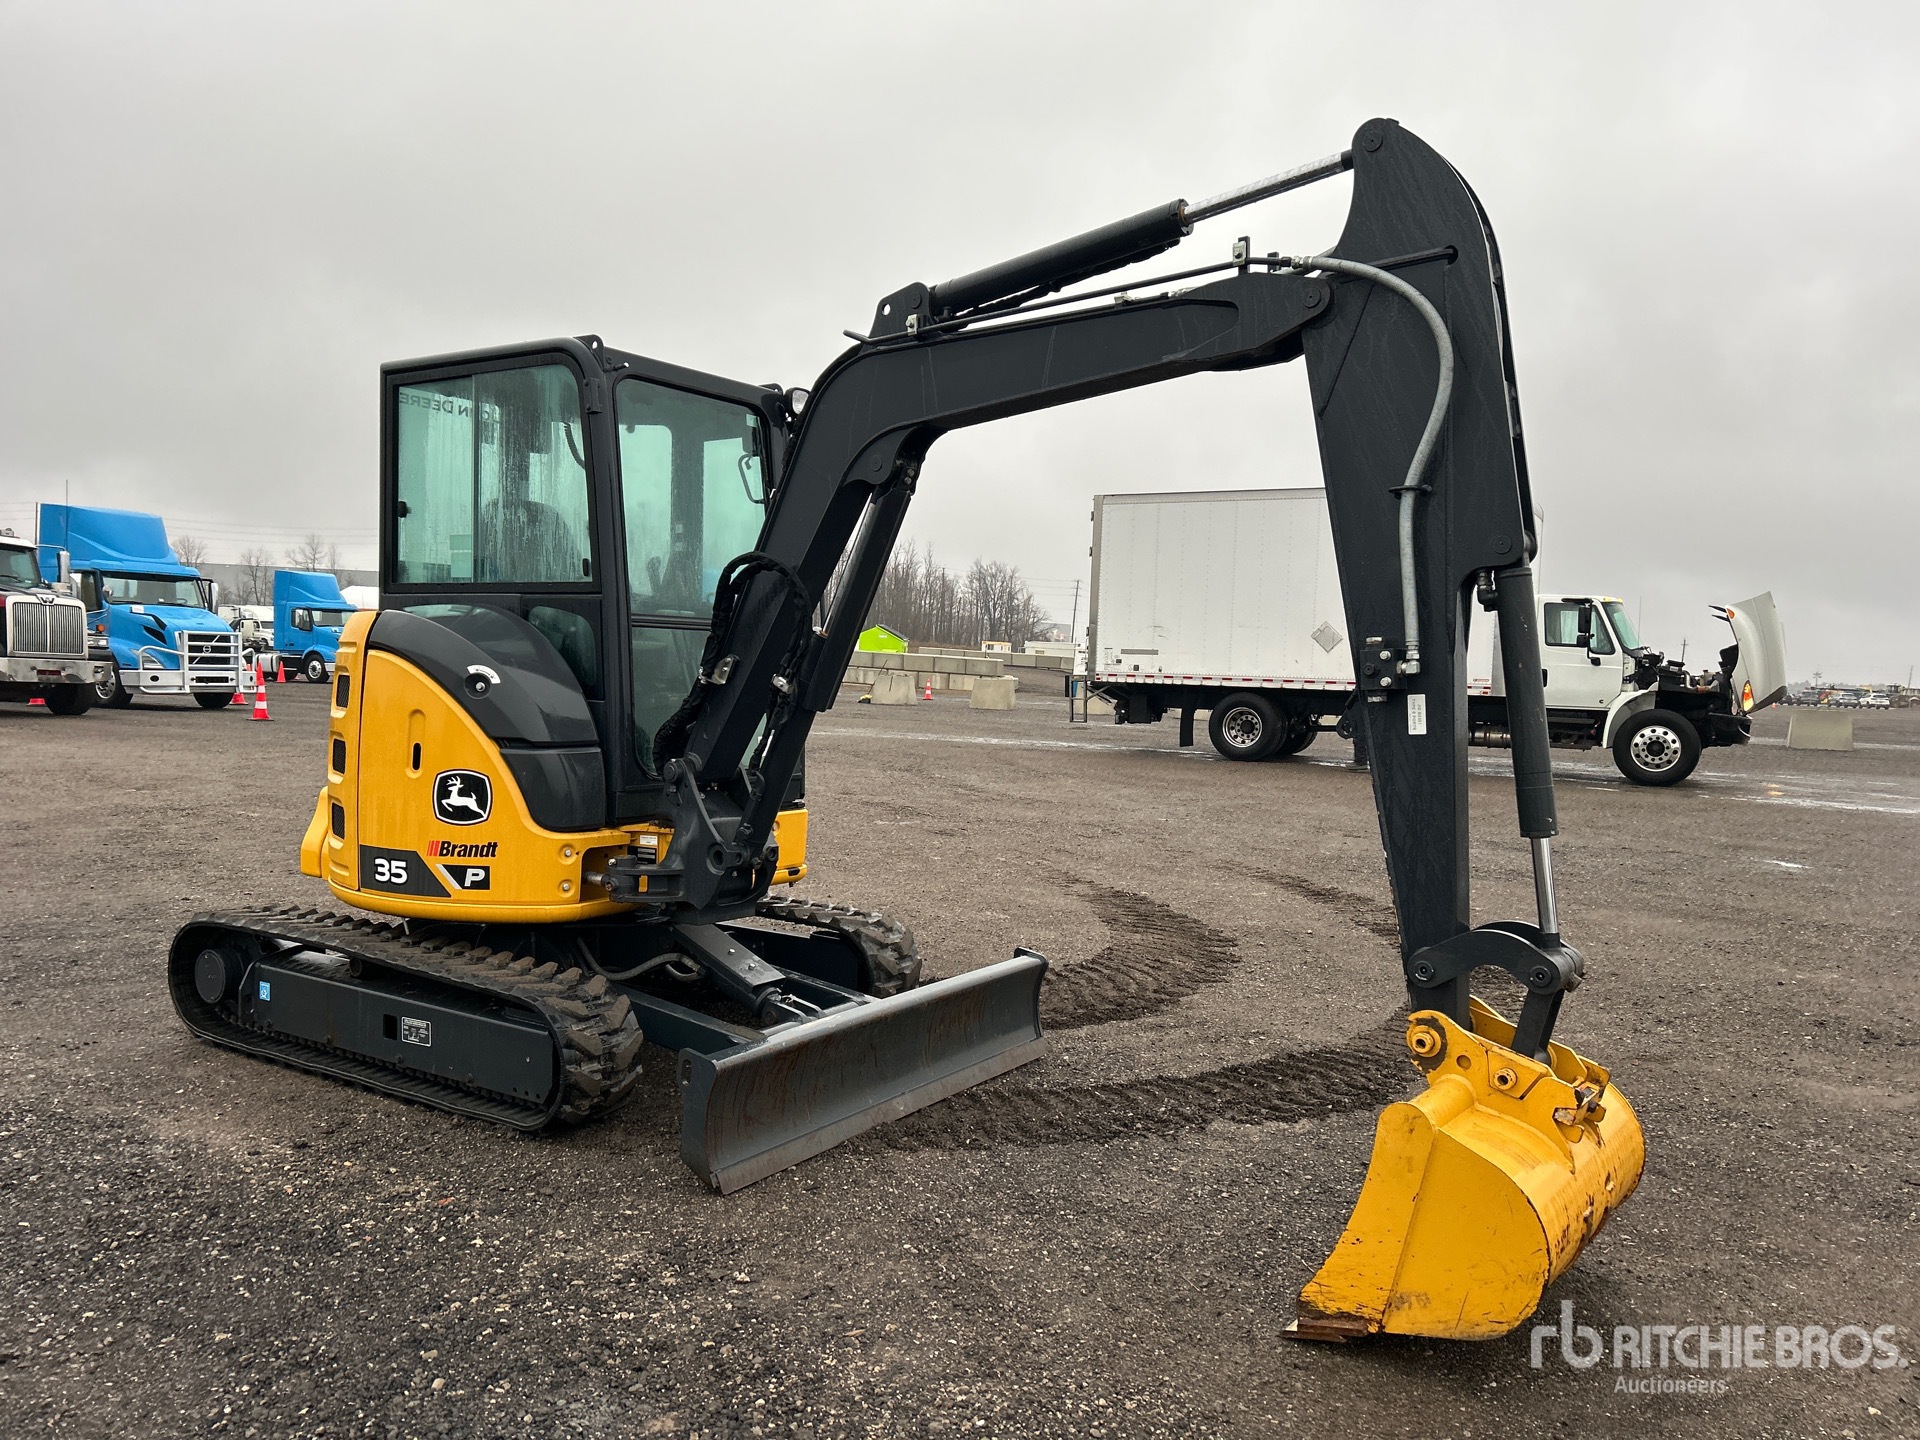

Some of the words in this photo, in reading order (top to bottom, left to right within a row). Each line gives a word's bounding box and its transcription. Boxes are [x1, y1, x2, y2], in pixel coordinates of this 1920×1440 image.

[439, 841, 498, 858] Brandt
[374, 858, 408, 884] 35
[464, 868, 486, 887] P
